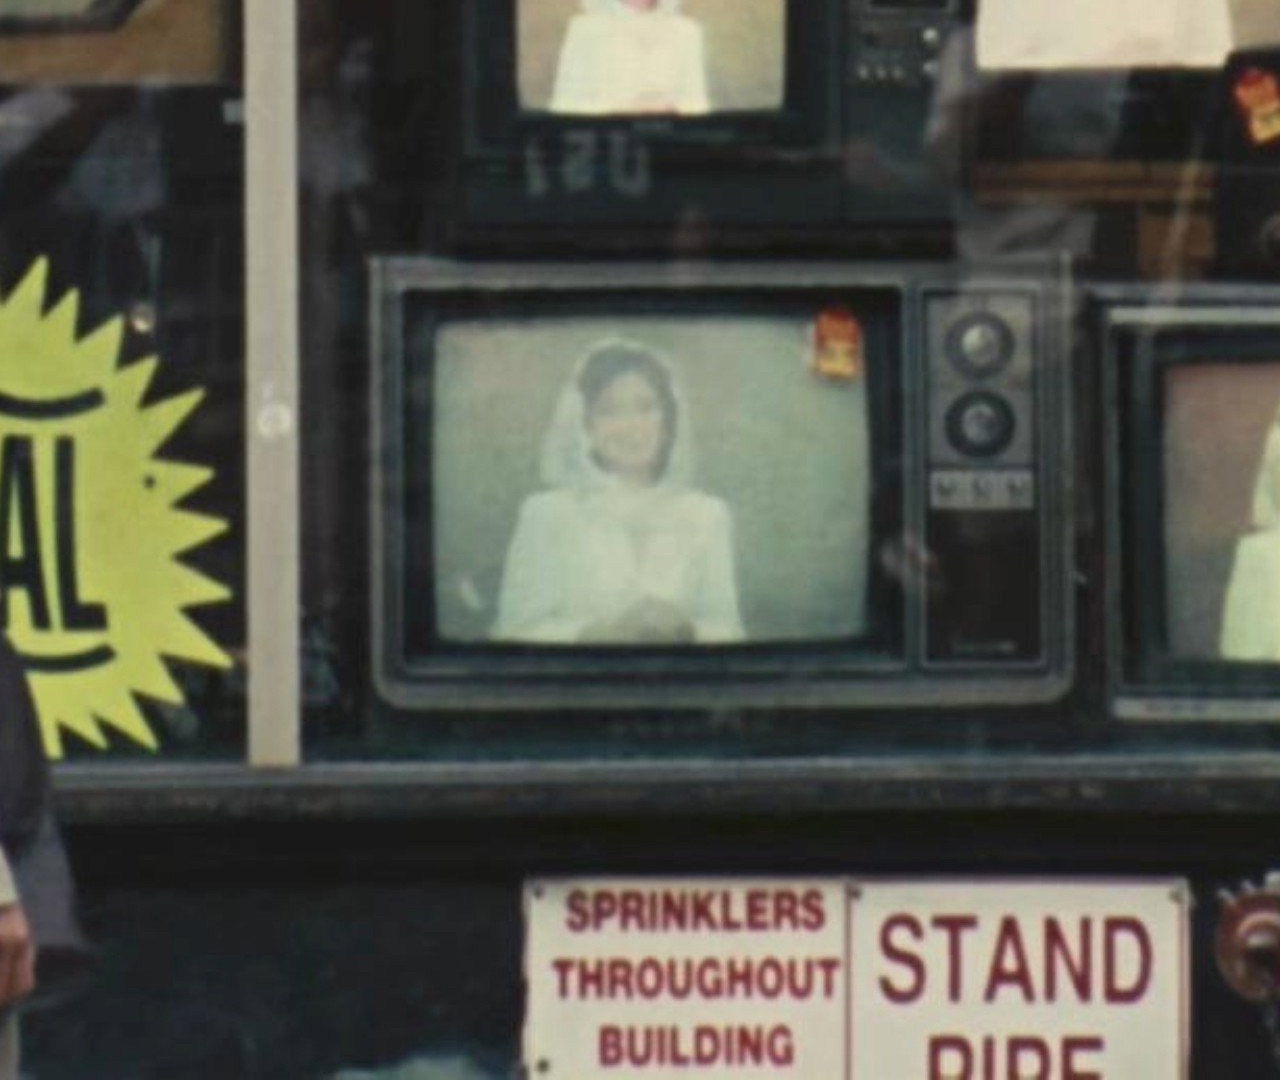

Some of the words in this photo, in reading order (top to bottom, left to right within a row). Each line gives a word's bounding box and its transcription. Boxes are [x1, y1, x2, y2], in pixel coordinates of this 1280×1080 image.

[565, 888, 826, 933] SPRINKLERS
[552, 957, 841, 1000] THROUGHOUT
[878, 913, 1153, 1005] STAND
[599, 1024, 795, 1067] BUILDING
